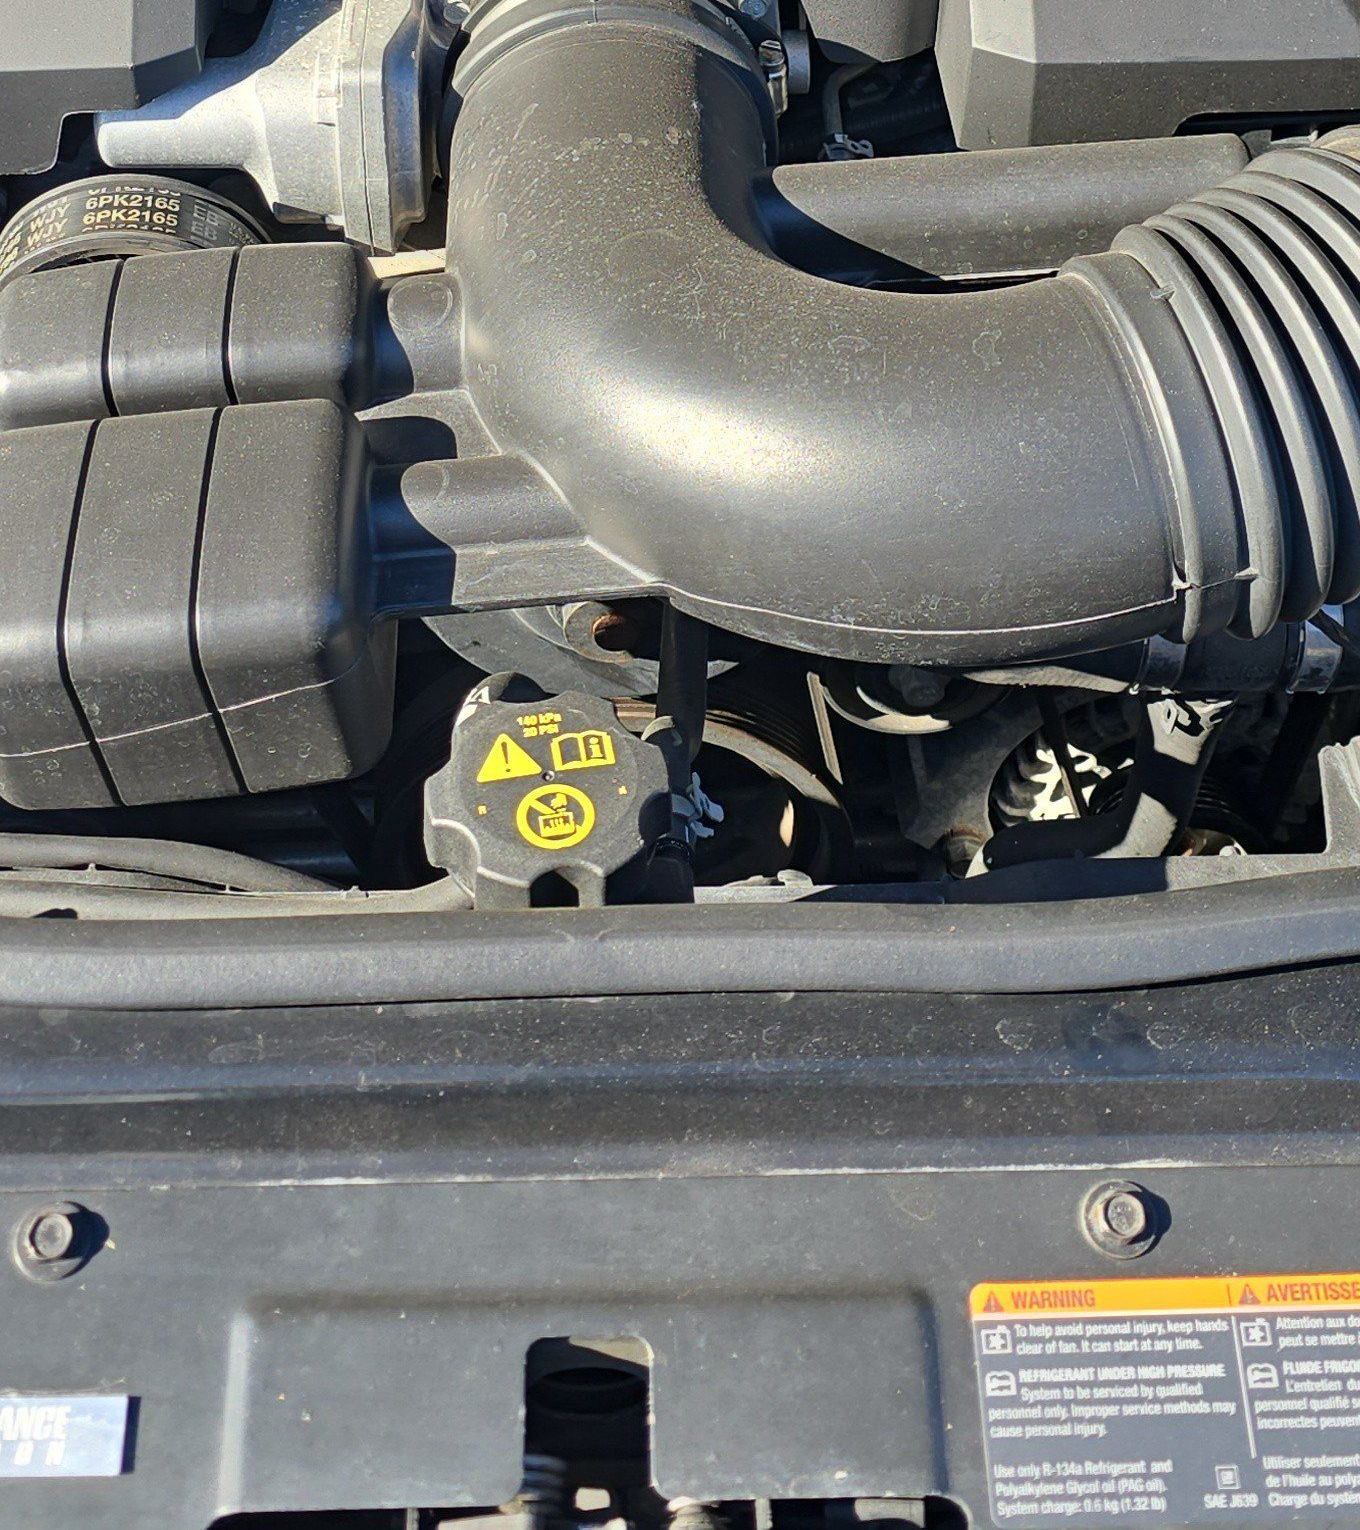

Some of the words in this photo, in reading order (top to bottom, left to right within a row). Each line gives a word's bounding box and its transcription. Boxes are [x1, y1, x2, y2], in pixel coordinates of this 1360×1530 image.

[30, 202, 72, 233] WJY
[85, 194, 181, 212] 6PK2165
[27, 217, 69, 247] WJY
[82, 208, 178, 226] 6PK2165
[523, 727, 538, 737] 20
[1011, 1289, 1095, 1310] WARNING
[1014, 1323, 1026, 1337] To
[1029, 1322, 1052, 1339] help
[1055, 1321, 1082, 1336] avoid
[1086, 1321, 1131, 1339] personal
[1133, 1320, 1165, 1337] injury,
[1167, 1319, 1192, 1336] keep
[1195, 1318, 1228, 1332] hands
[1276, 1316, 1324, 1329] Attention
[1326, 1318, 1346, 1328] aux
[1016, 1341, 1042, 1355] clear
[1045, 1340, 1057, 1353] of
[1058, 1339, 1079, 1353] fan.
[1091, 1340, 1111, 1352] can
[1114, 1338, 1138, 1351] start
[1140, 1338, 1151, 1351] at
[1154, 1339, 1173, 1354] any
[1175, 1336, 1204, 1350] time.
[1278, 1334, 1304, 1350] peut
[1305, 1336, 1318, 1346] se
[1320, 1333, 1356, 1345] mettre
[1018, 1367, 1095, 1383] REFRIGERANT
[1097, 1366, 1136, 1381] UNDER
[1137, 1365, 1165, 1380] HIGH
[1166, 1363, 1226, 1378] PRESSURE
[1283, 1360, 1322, 1375] FLUIDE
[1021, 1385, 1061, 1403] System
[1063, 1385, 1073, 1399] to
[1076, 1384, 1090, 1399] be
[1093, 1383, 1139, 1398] serviced
[1141, 1383, 1154, 1400] by
[1156, 1382, 1203, 1399] qualified
[1347, 1378, 1360, 1390] du
[988, 1405, 1042, 1421] personnel
[1071, 1402, 1119, 1418] Improper
[1122, 1401, 1162, 1415] service
[1163, 1400, 1210, 1414] methods
[1212, 1401, 1236, 1416] may
[1254, 1398, 1308, 1413] personnel
[1309, 1397, 1350, 1411] qualifié
[990, 1426, 1022, 1438] cause
[1025, 1423, 1072, 1439] personal
[1074, 1422, 1108, 1438] injury.
[1257, 1416, 1318, 1430] incorrectes
[993, 1463, 1014, 1478] Use
[1017, 1463, 1039, 1479] only
[1042, 1462, 1082, 1476] R-134a
[1084, 1460, 1146, 1478] Refrigerant
[1151, 1459, 1173, 1472] and
[1263, 1455, 1302, 1470] Utiliser
[1304, 1454, 1360, 1468] seulement
[995, 1481, 1063, 1499] Polyalkylene
[1065, 1479, 1096, 1496] Glycol
[1098, 1479, 1115, 1492] oil
[1117, 1479, 1144, 1494] (PAG
[1265, 1475, 1280, 1488] de
[1319, 1474, 1332, 1486] au
[996, 1502, 1039, 1518] System
[1042, 1500, 1081, 1516] charge:
[1083, 1498, 1101, 1513] 0.6
[1104, 1498, 1119, 1515] kg
[1120, 1497, 1149, 1513] (1.32
[1151, 1496, 1167, 1512] lb)
[1204, 1494, 1228, 1509] SAE
[1230, 1492, 1259, 1508] J639
[1268, 1492, 1308, 1508] Charge
[1310, 1492, 1325, 1505] du
